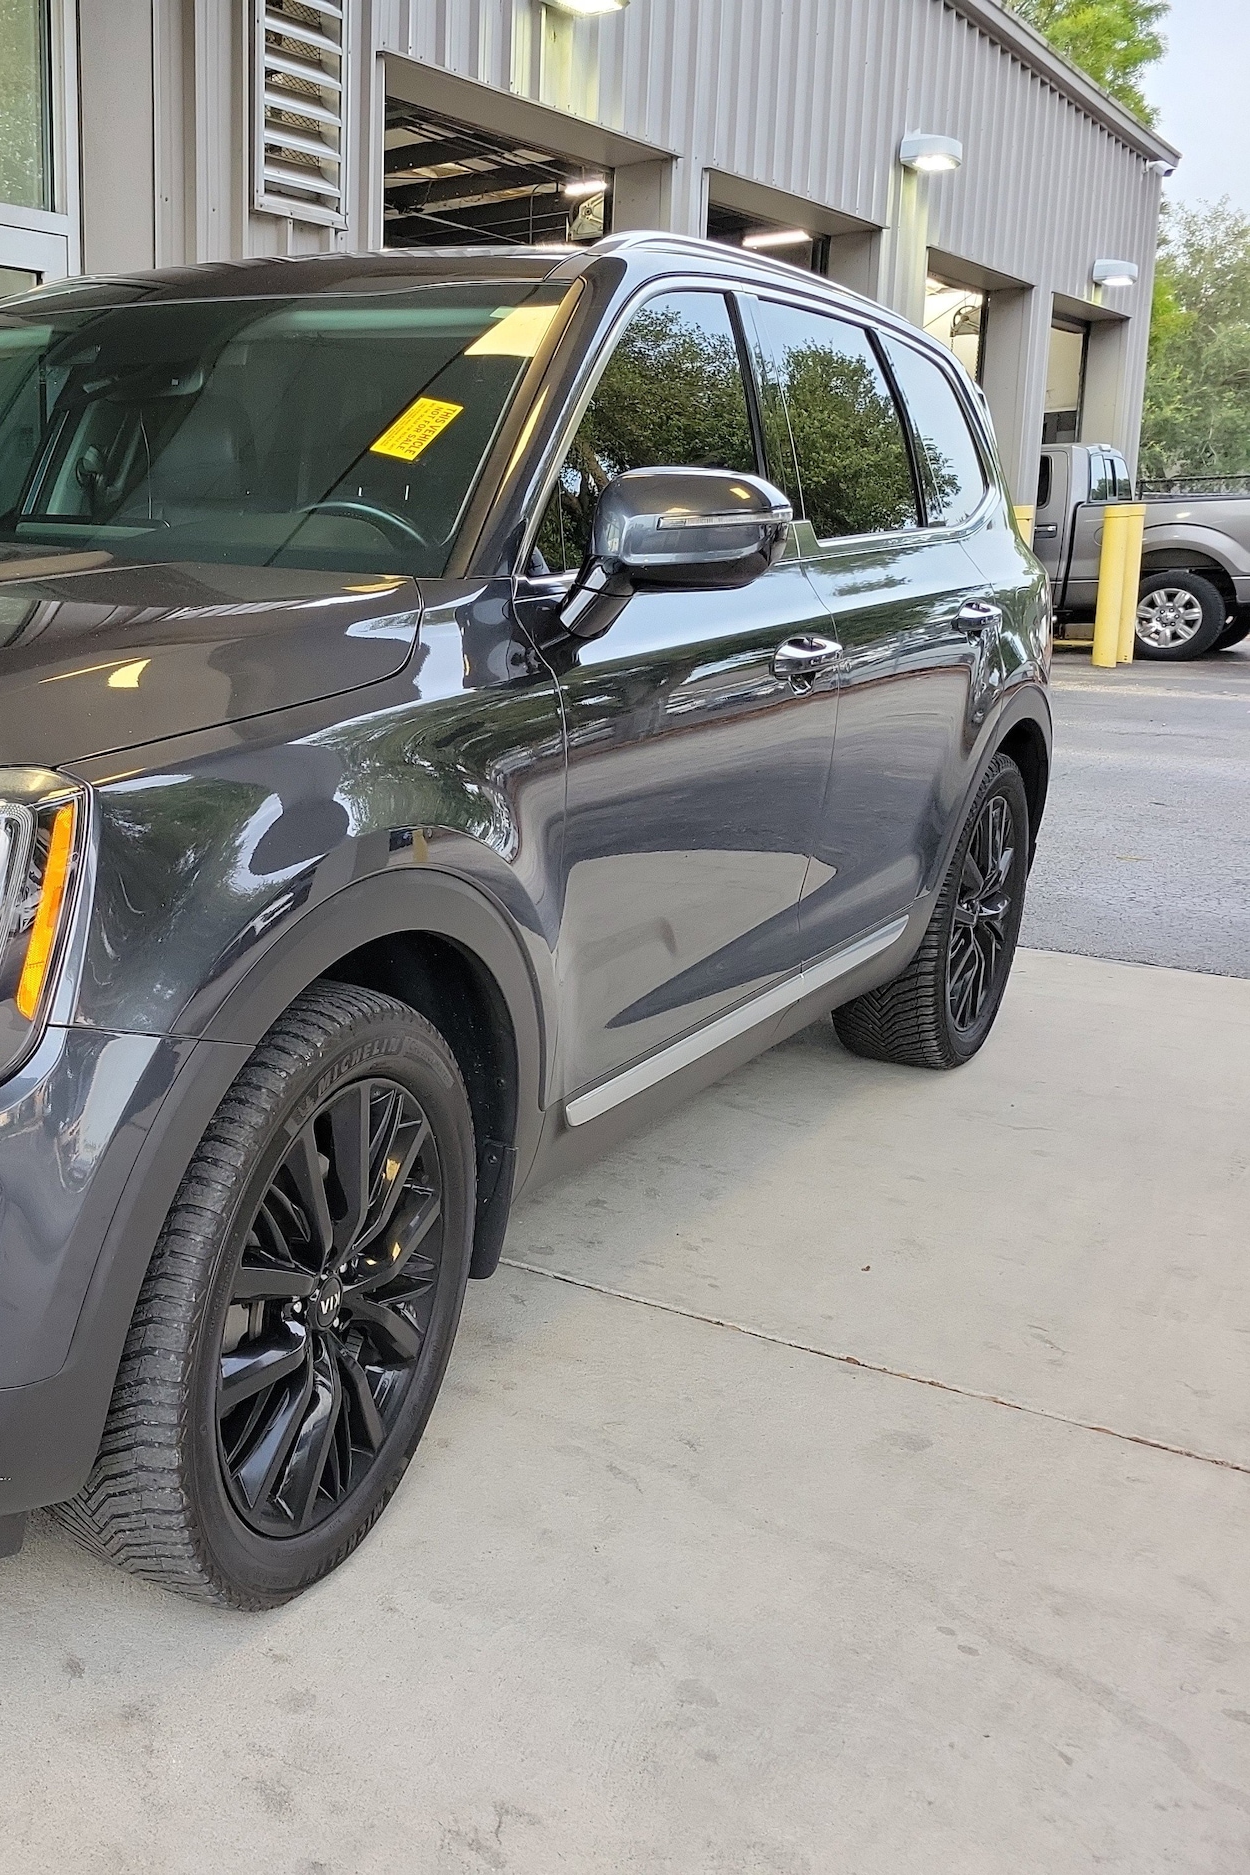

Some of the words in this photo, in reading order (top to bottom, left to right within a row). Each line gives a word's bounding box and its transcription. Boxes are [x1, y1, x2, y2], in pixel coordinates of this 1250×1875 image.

[428, 406, 444, 419] NOT
[435, 408, 458, 424] THIS
[414, 420, 430, 433] FOR
[397, 434, 416, 450] SALE
[404, 425, 441, 455] VEHICLE
[317, 1037, 402, 1096] MICHELIN
[320, 1291, 341, 1315] KIA
